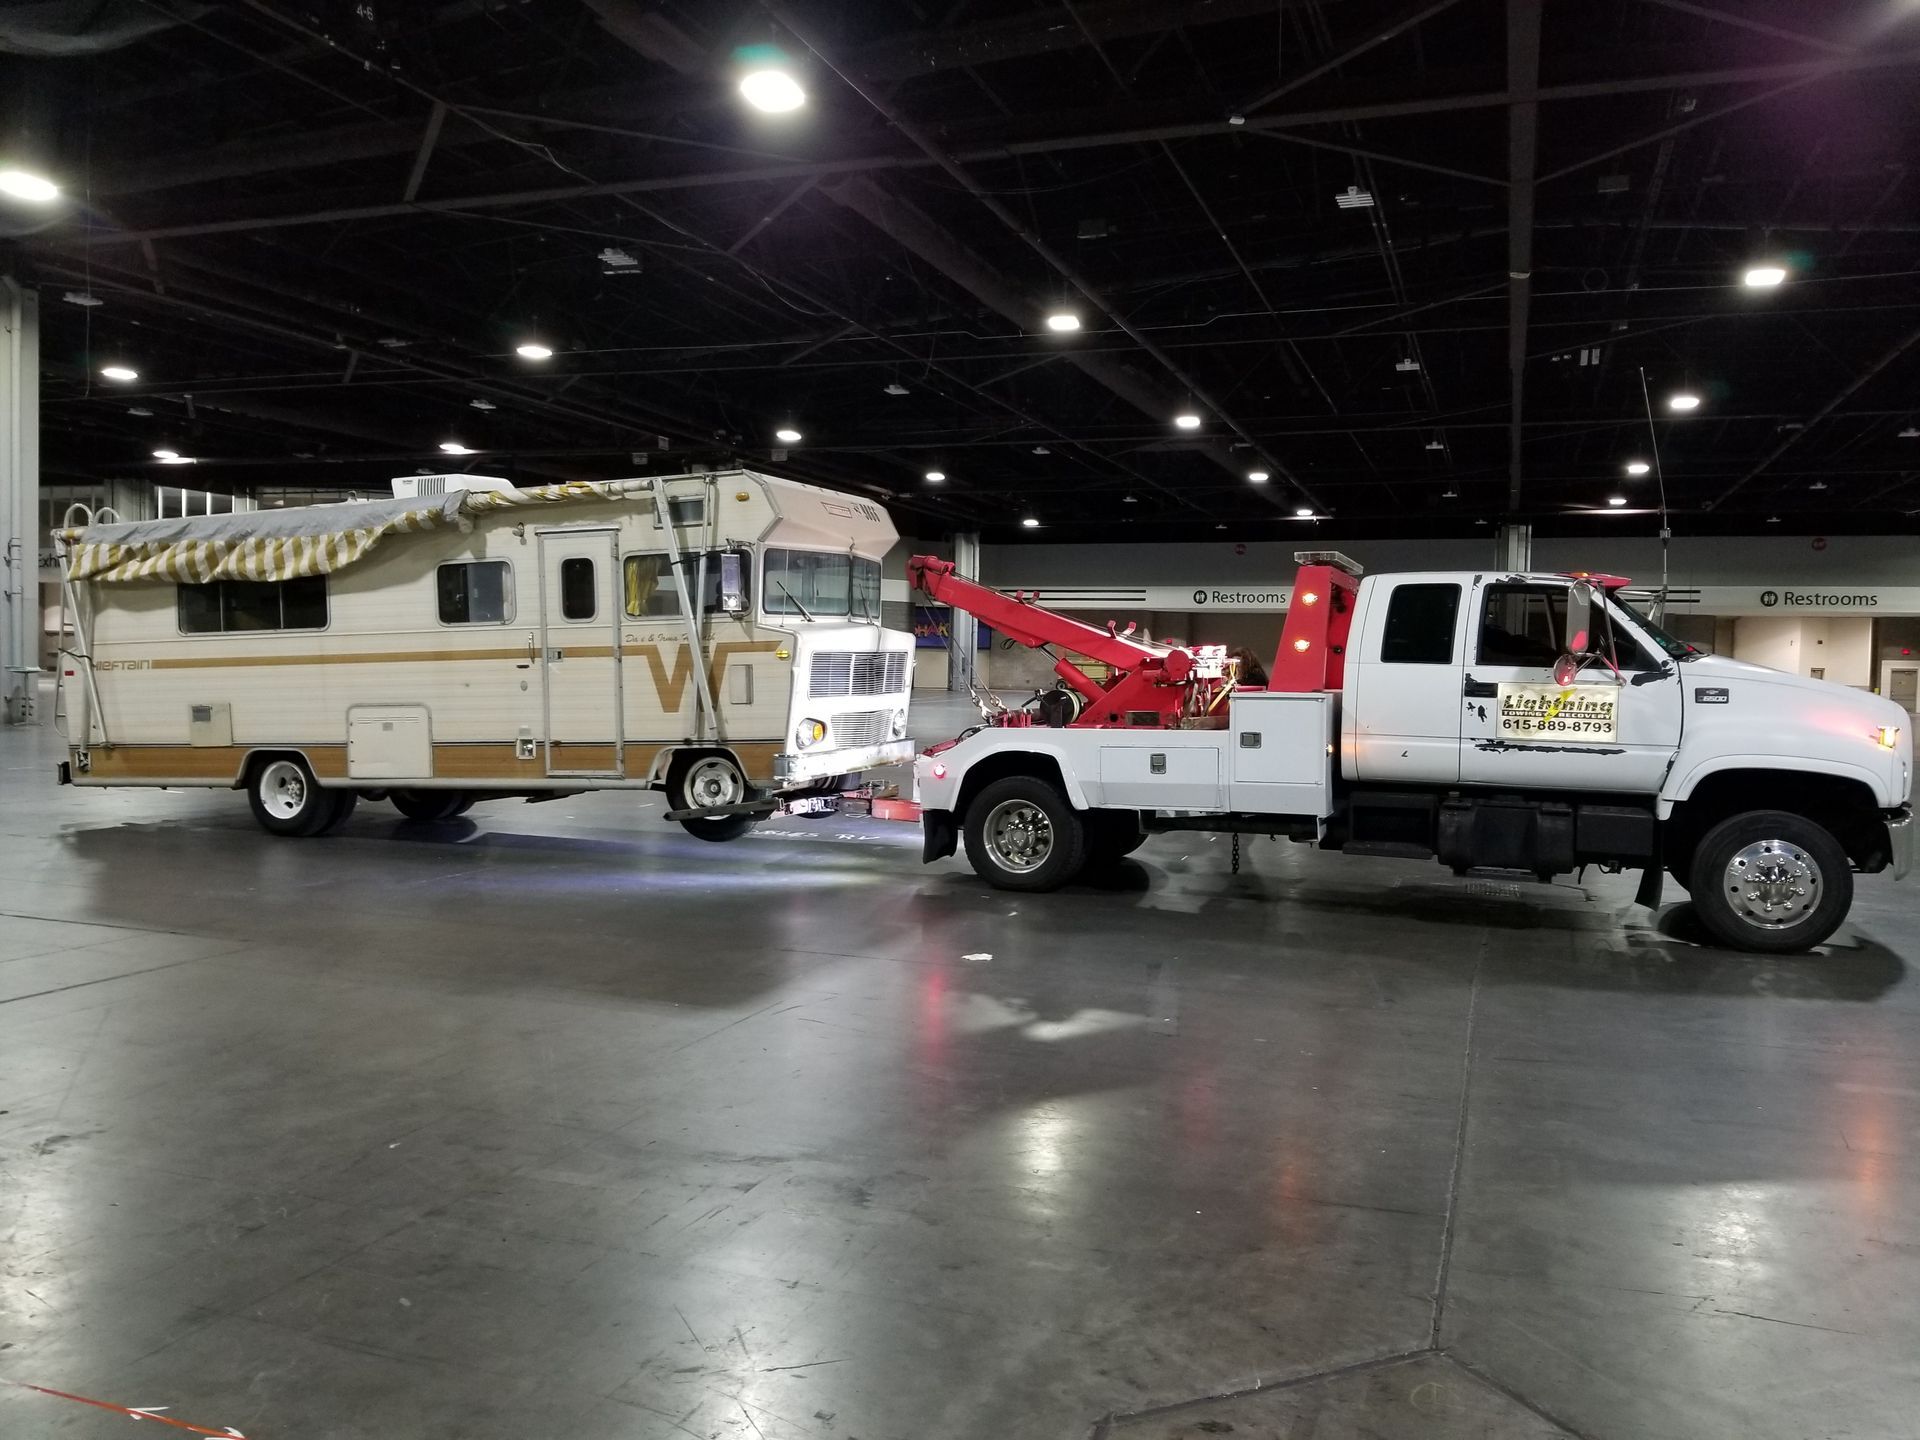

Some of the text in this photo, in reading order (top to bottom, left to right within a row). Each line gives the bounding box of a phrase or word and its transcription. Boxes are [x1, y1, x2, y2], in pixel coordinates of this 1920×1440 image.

[1212, 590, 1286, 604] Restrooms
[1783, 591, 1878, 606] Restrooms
[1502, 694, 1614, 715] Lightning
[1558, 712, 1611, 720] RECOVERY
[1502, 719, 1612, 733] 615-889-8793
